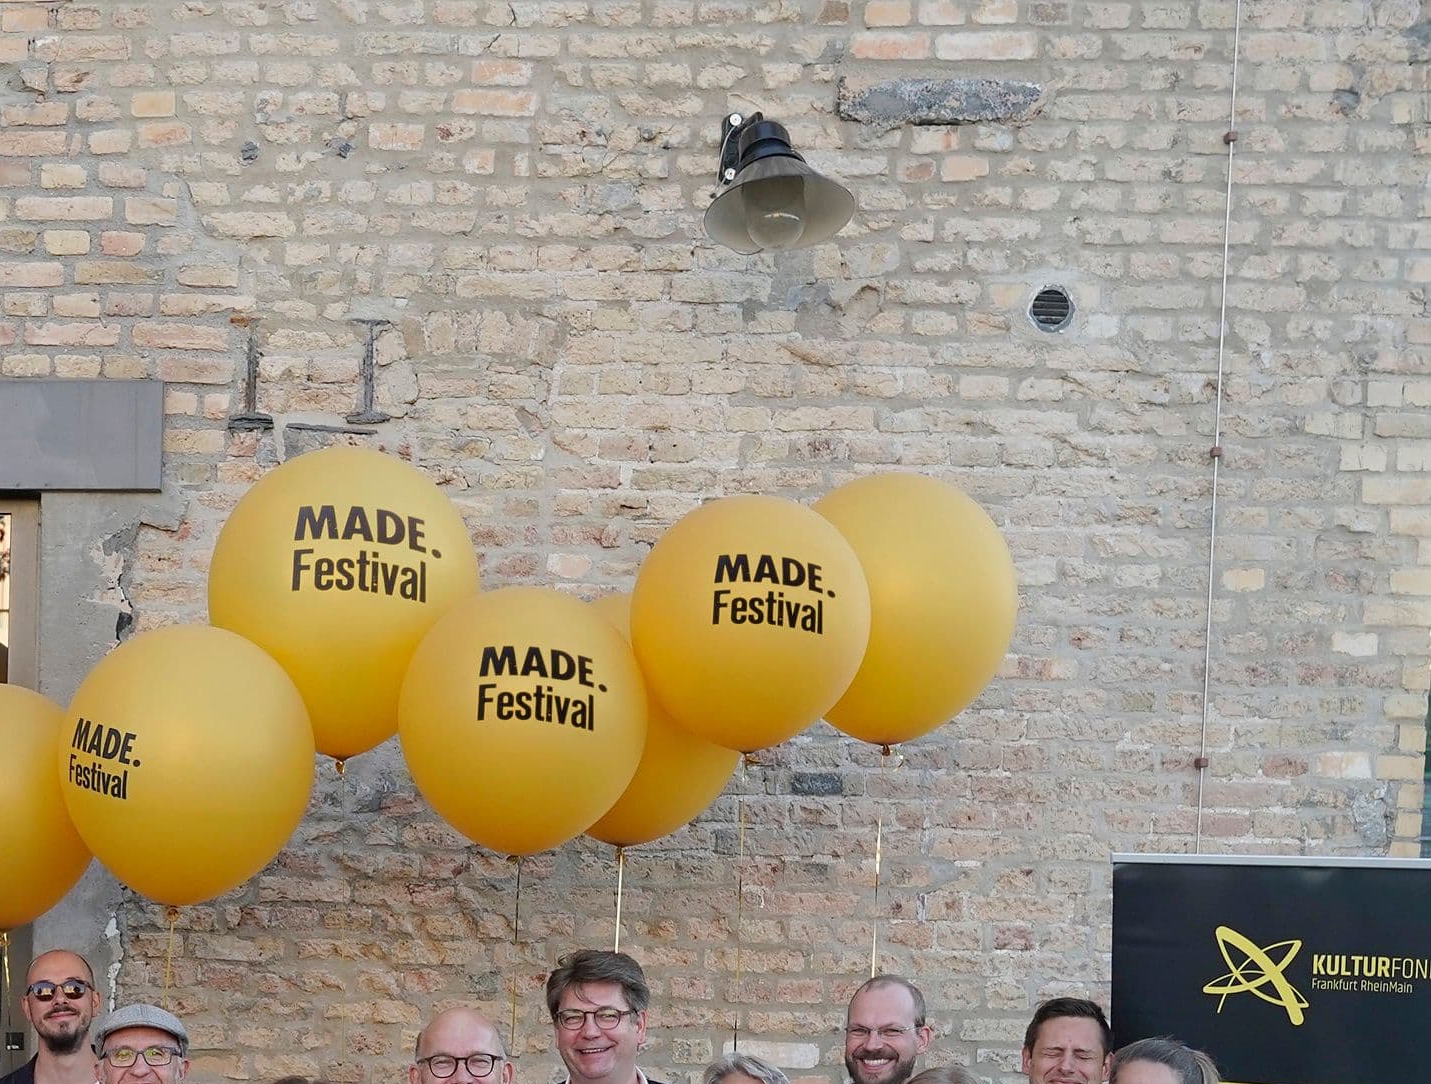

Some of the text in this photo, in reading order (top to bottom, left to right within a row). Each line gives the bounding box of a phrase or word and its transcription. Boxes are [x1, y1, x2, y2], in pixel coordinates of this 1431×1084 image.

[294, 504, 443, 559] MADE.
[291, 548, 427, 604] Festival
[714, 553, 837, 599] MADE.
[712, 589, 824, 635] Festival
[479, 645, 608, 693] MADE.
[476, 683, 595, 732] Festival
[71, 717, 142, 768] MADE.
[69, 753, 128, 800] Festival
[1311, 978, 1414, 994] Frankfurt RheinMain
[1312, 954, 1431, 980] KULTURFON
